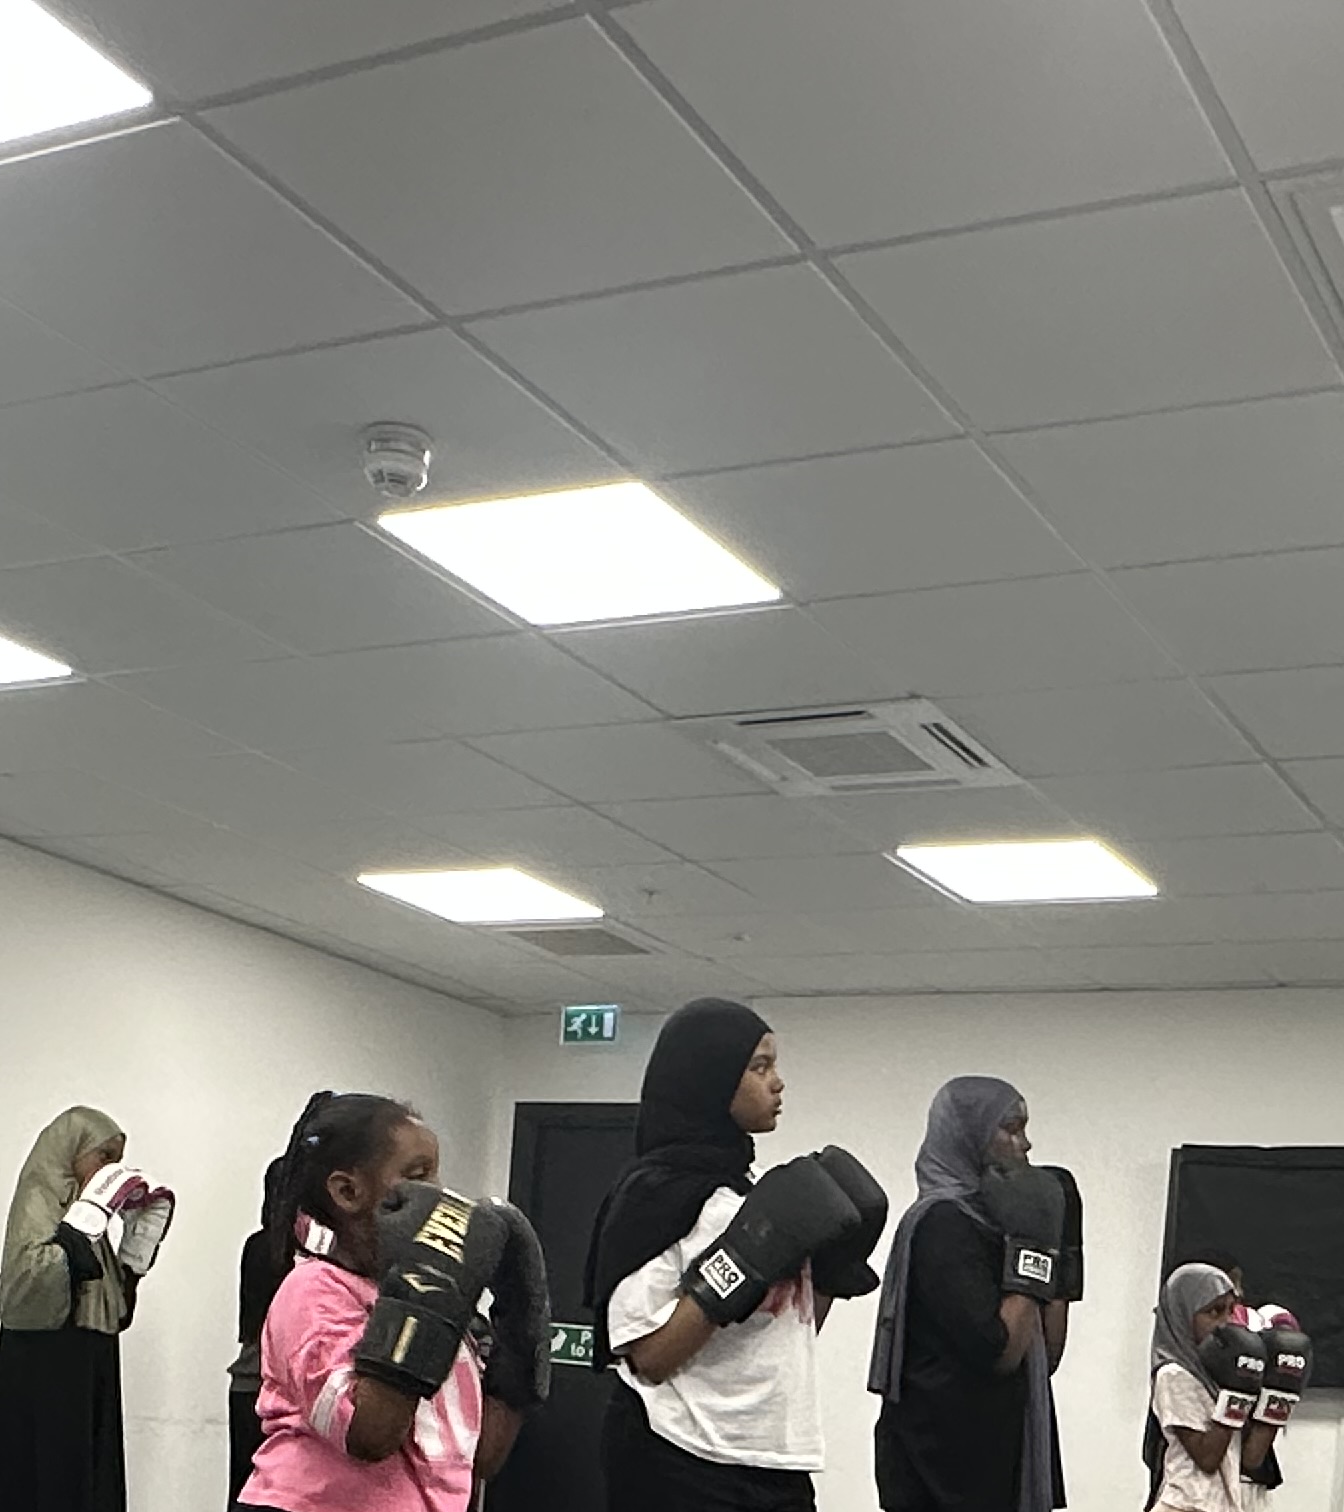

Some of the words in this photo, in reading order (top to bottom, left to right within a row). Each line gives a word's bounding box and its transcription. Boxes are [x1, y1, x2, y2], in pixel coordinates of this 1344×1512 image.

[709, 1254, 740, 1285] PRO
[570, 1342, 586, 1358] to
[1237, 1355, 1264, 1372] PRO
[1278, 1353, 1306, 1370] PRO
